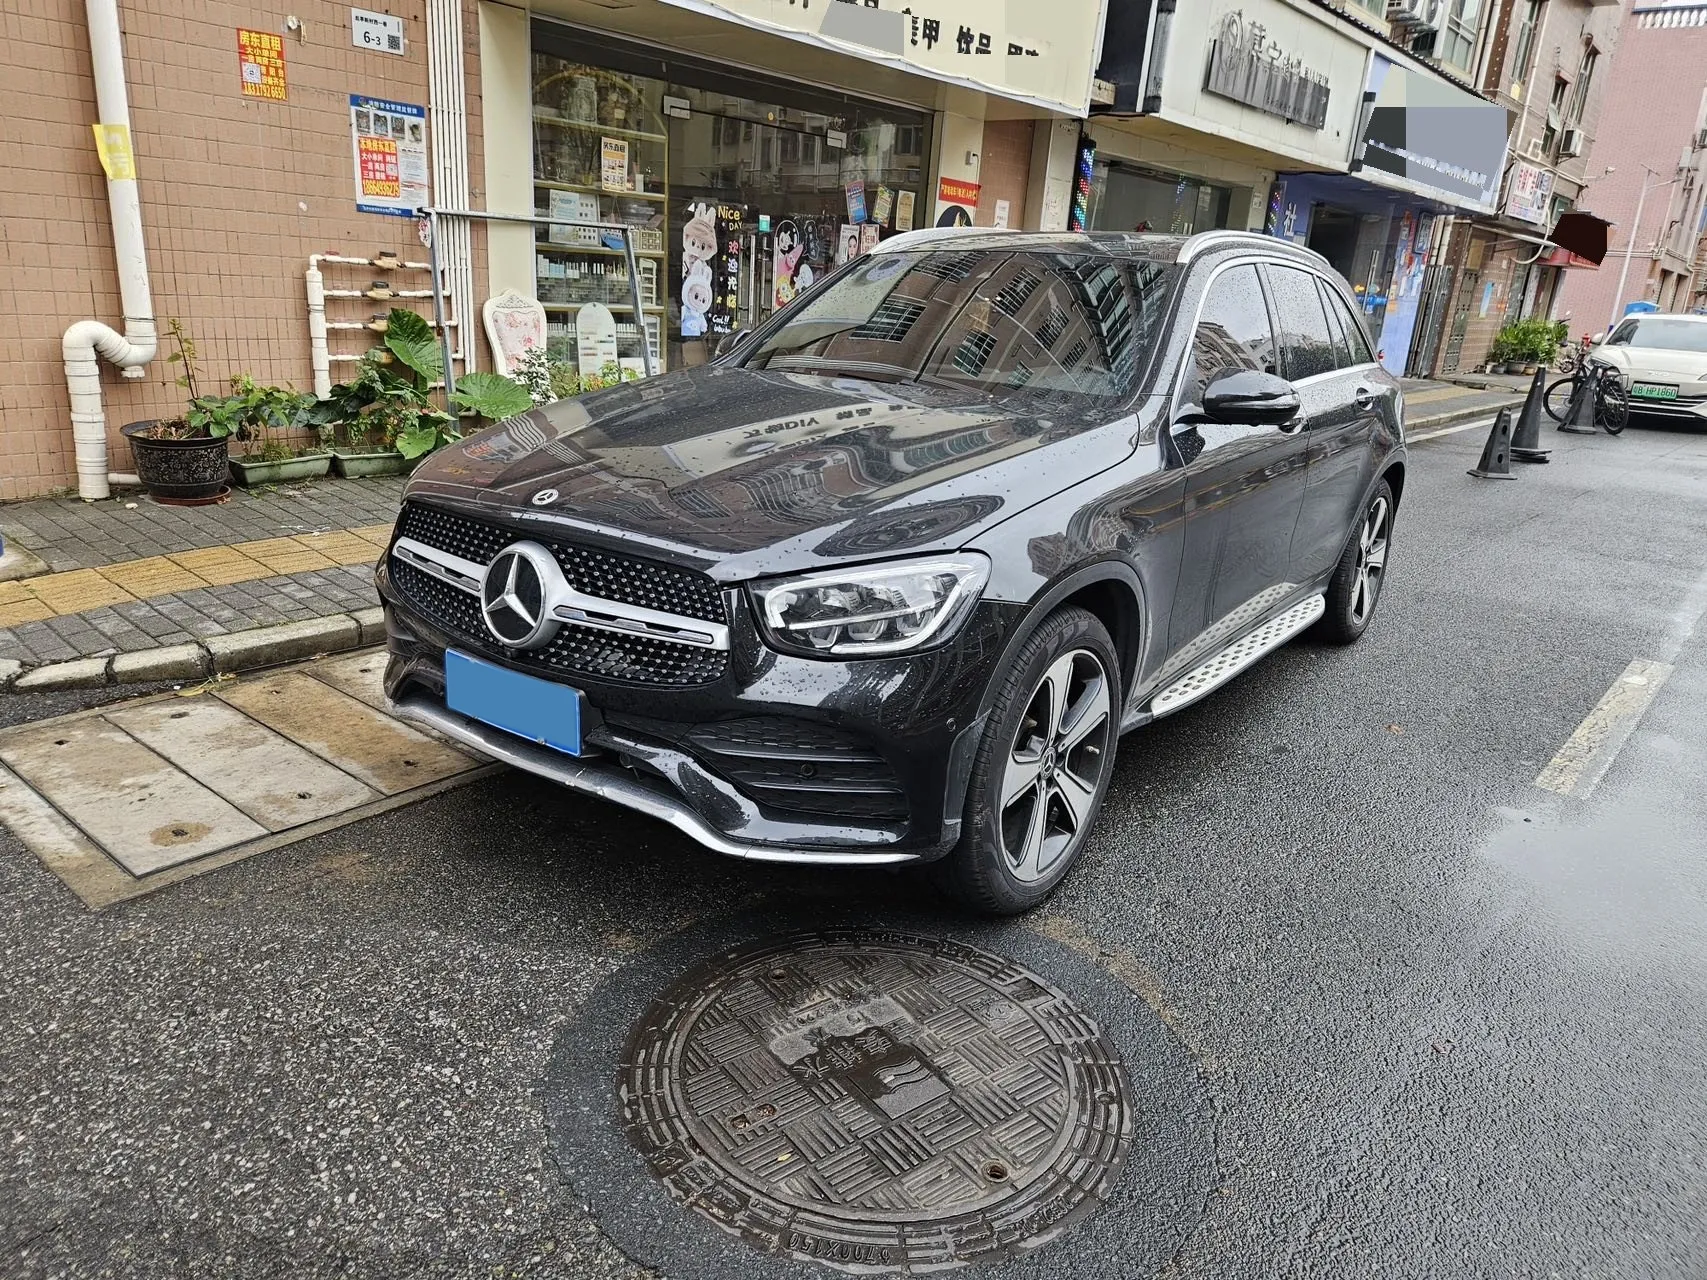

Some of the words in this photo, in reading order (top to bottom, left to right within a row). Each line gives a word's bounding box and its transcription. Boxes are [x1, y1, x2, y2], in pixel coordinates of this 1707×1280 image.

[240, 31, 281, 51] 房东直租
[363, 31, 381, 46] 6-3
[718, 205, 741, 220] Nice
[1283, 202, 1297, 236] 社
[728, 221, 742, 231] DAY
[726, 240, 739, 308] 欢迎光临
